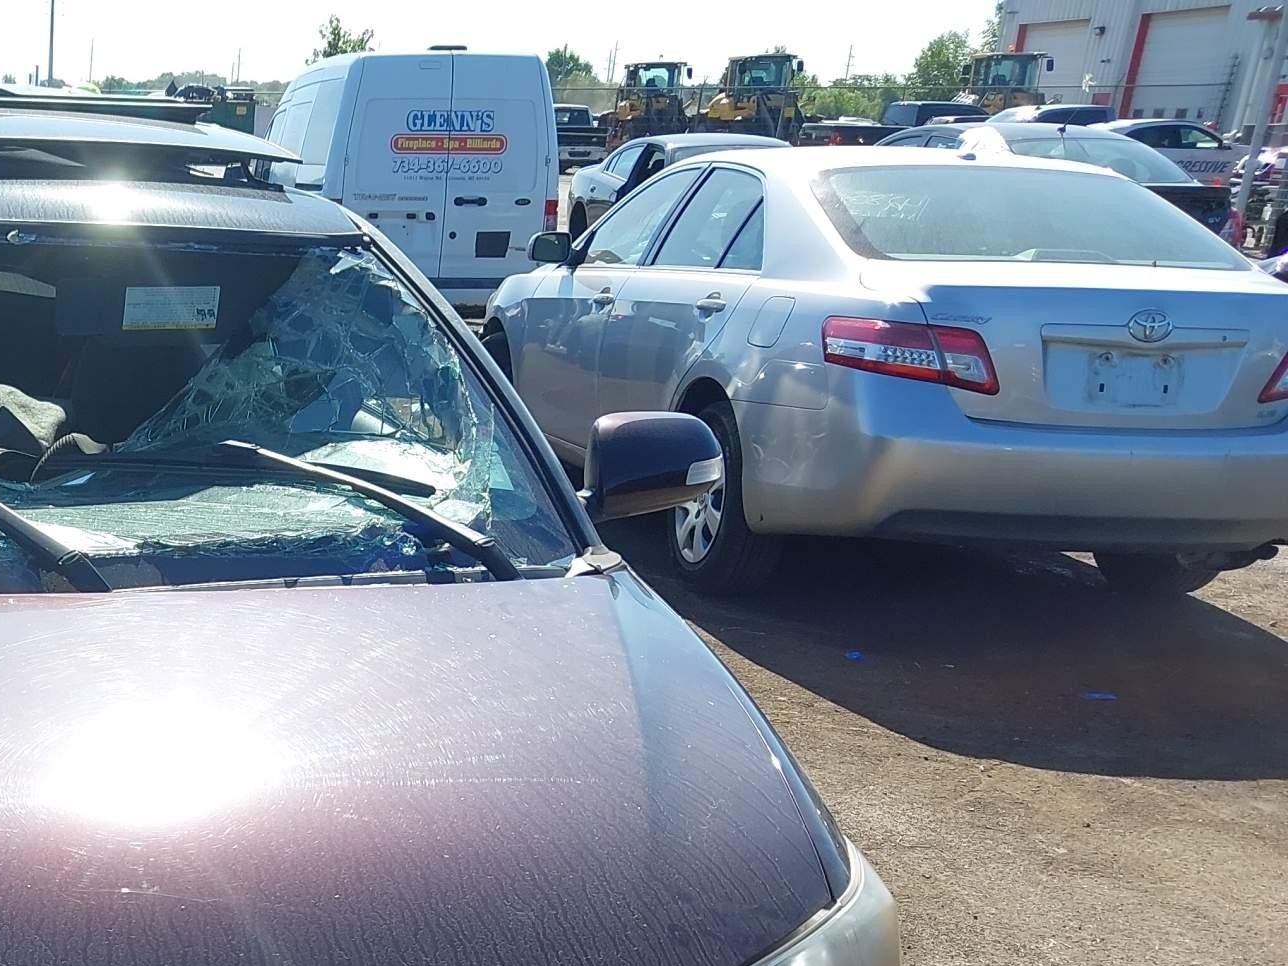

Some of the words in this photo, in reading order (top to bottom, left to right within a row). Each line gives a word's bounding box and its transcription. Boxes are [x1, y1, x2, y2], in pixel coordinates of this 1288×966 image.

[407, 110, 495, 132] GLENN'S
[397, 138, 437, 150] Fireplace
[442, 138, 460, 150] Spa
[466, 138, 501, 148] Billiards
